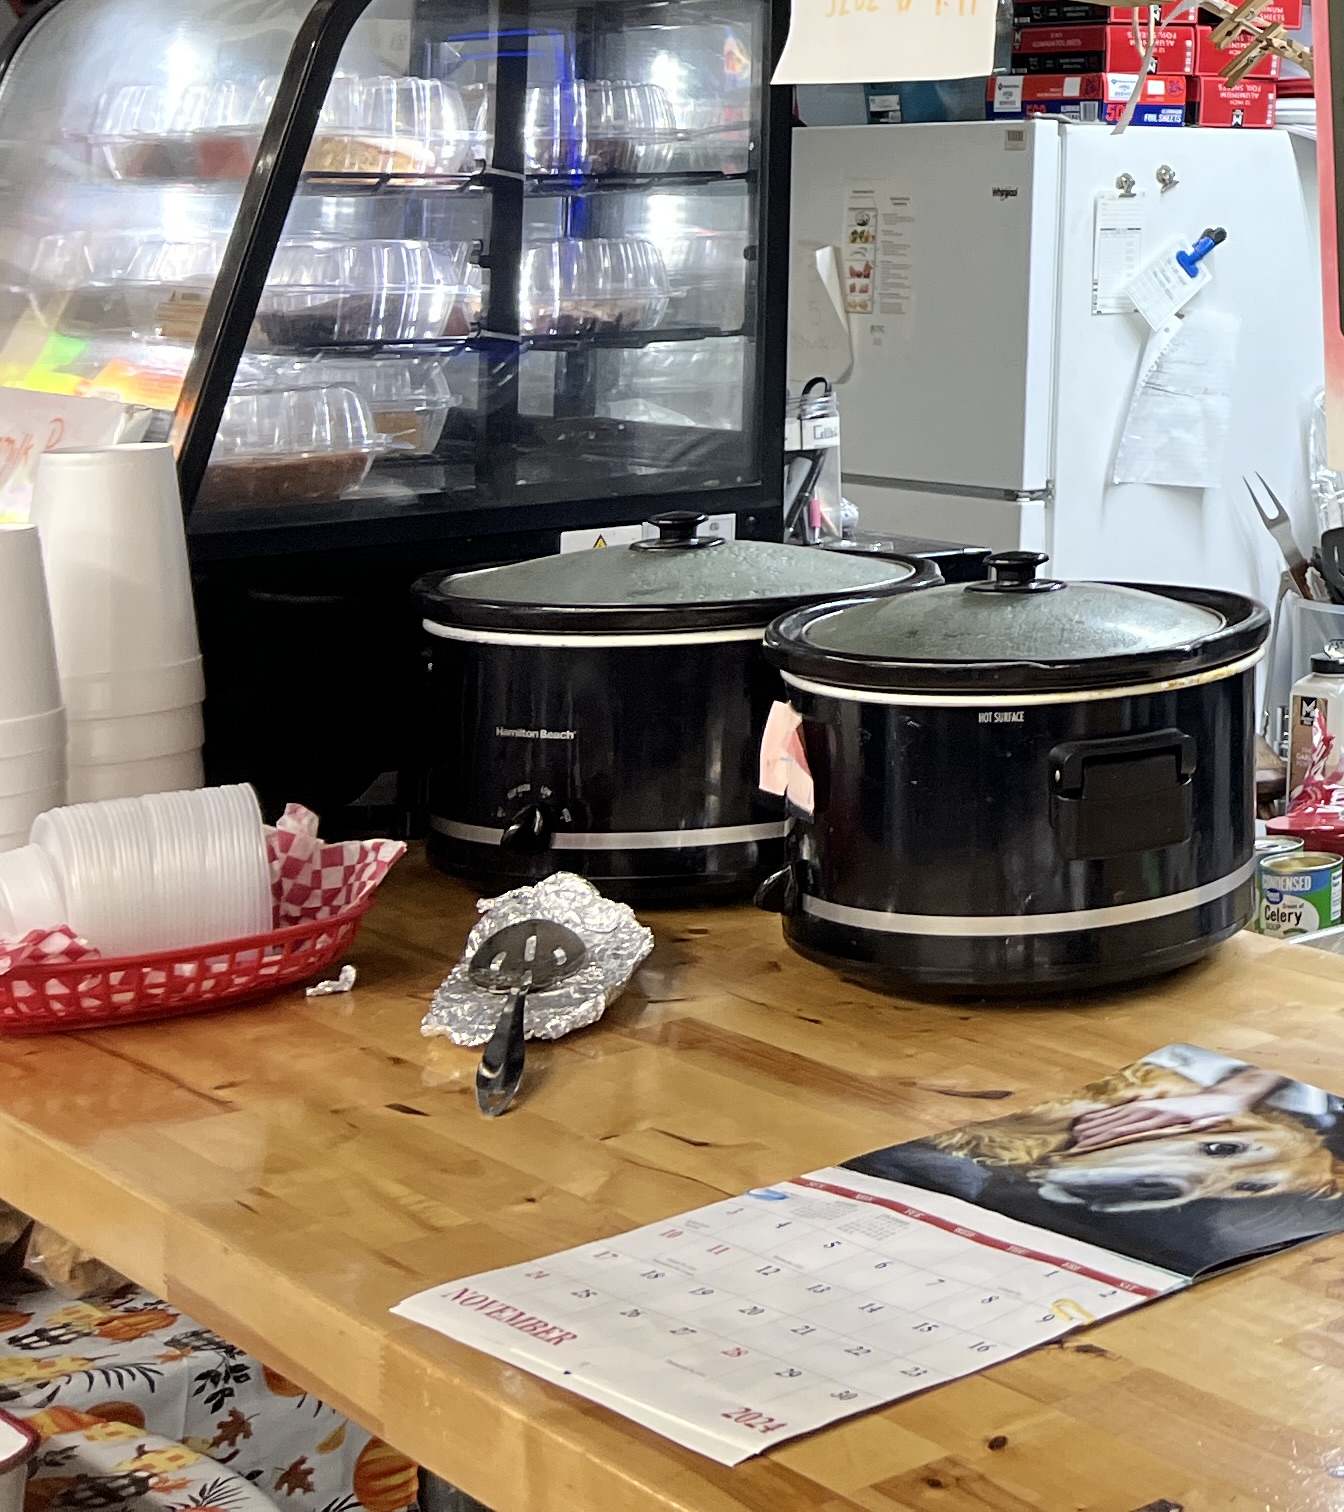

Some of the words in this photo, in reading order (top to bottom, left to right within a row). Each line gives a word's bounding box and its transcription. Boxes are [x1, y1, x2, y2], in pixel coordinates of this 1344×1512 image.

[978, 712, 992, 723] HOT
[994, 711, 1024, 723] SURFACE
[496, 727, 539, 740] Hamilton
[540, 728, 573, 740] Beach
[1264, 905, 1302, 926] Celery
[441, 1286, 578, 1347] NOVEMBER
[720, 1406, 790, 1435] 2024
